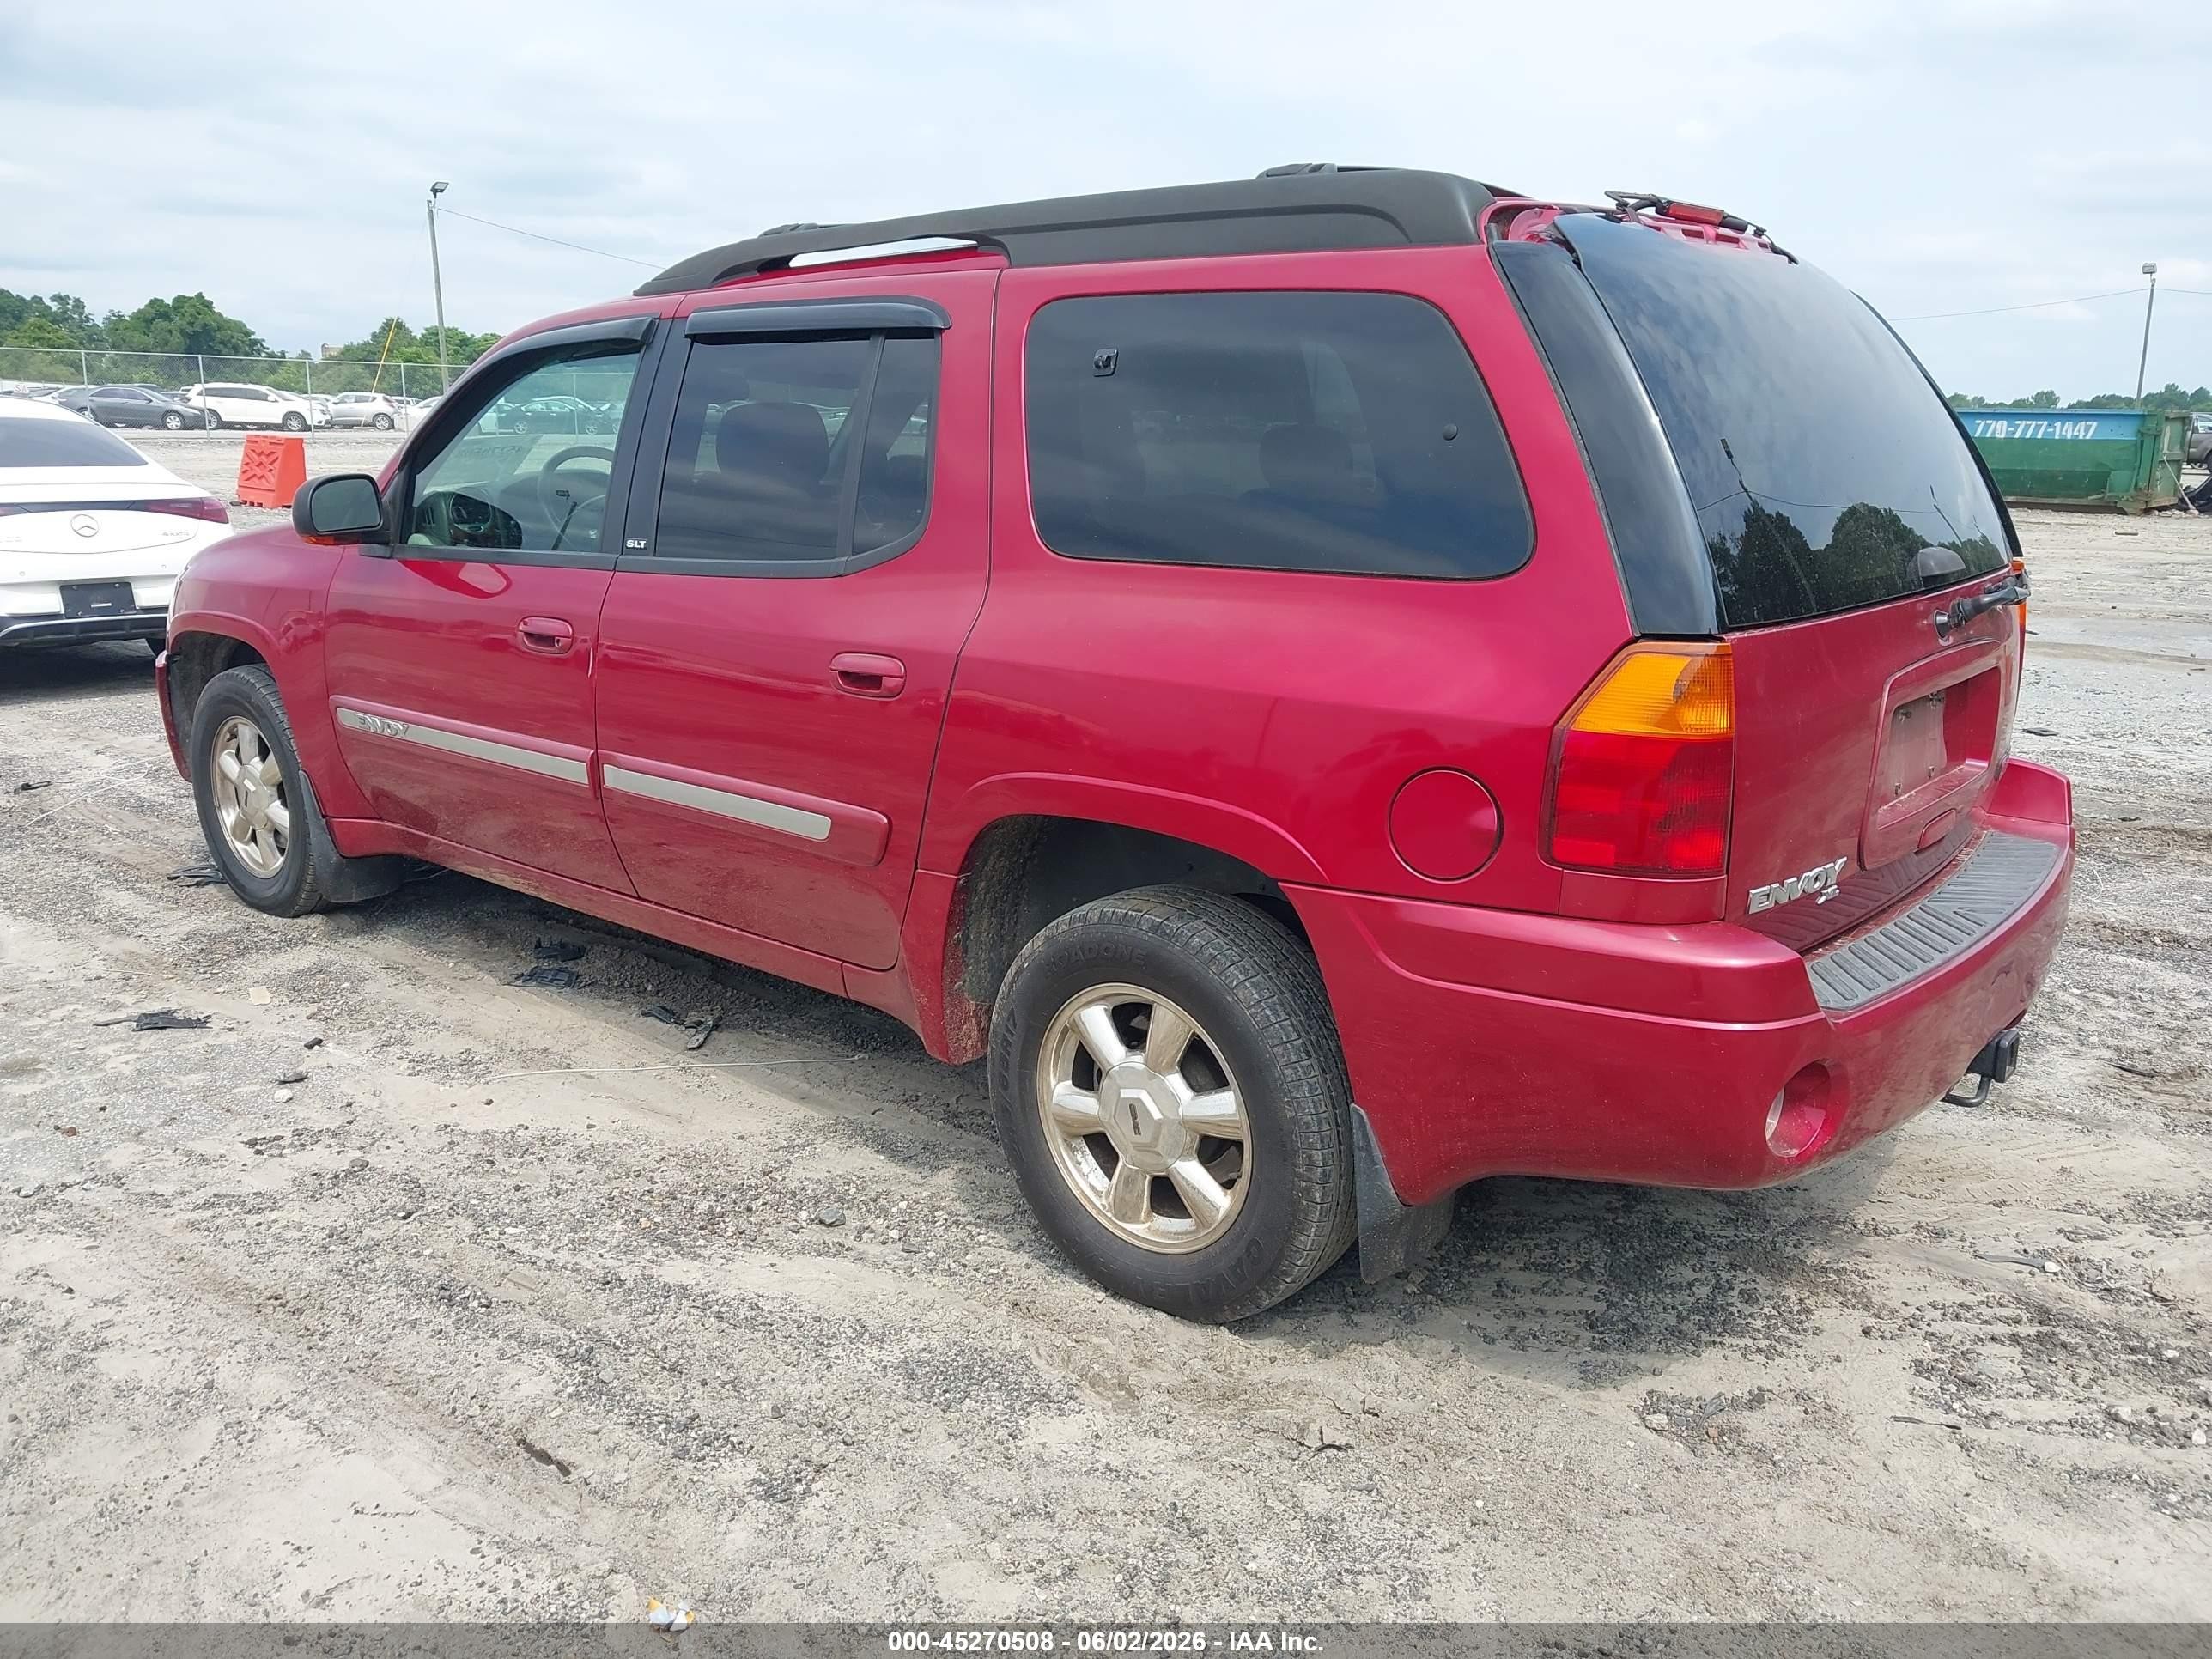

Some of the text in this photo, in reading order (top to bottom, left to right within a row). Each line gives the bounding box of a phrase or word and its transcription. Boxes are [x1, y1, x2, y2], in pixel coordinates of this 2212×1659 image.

[1974, 420, 2098, 439] 770-777-1447
[626, 539, 647, 549] SLT
[1749, 856, 1847, 915] ENVOY
